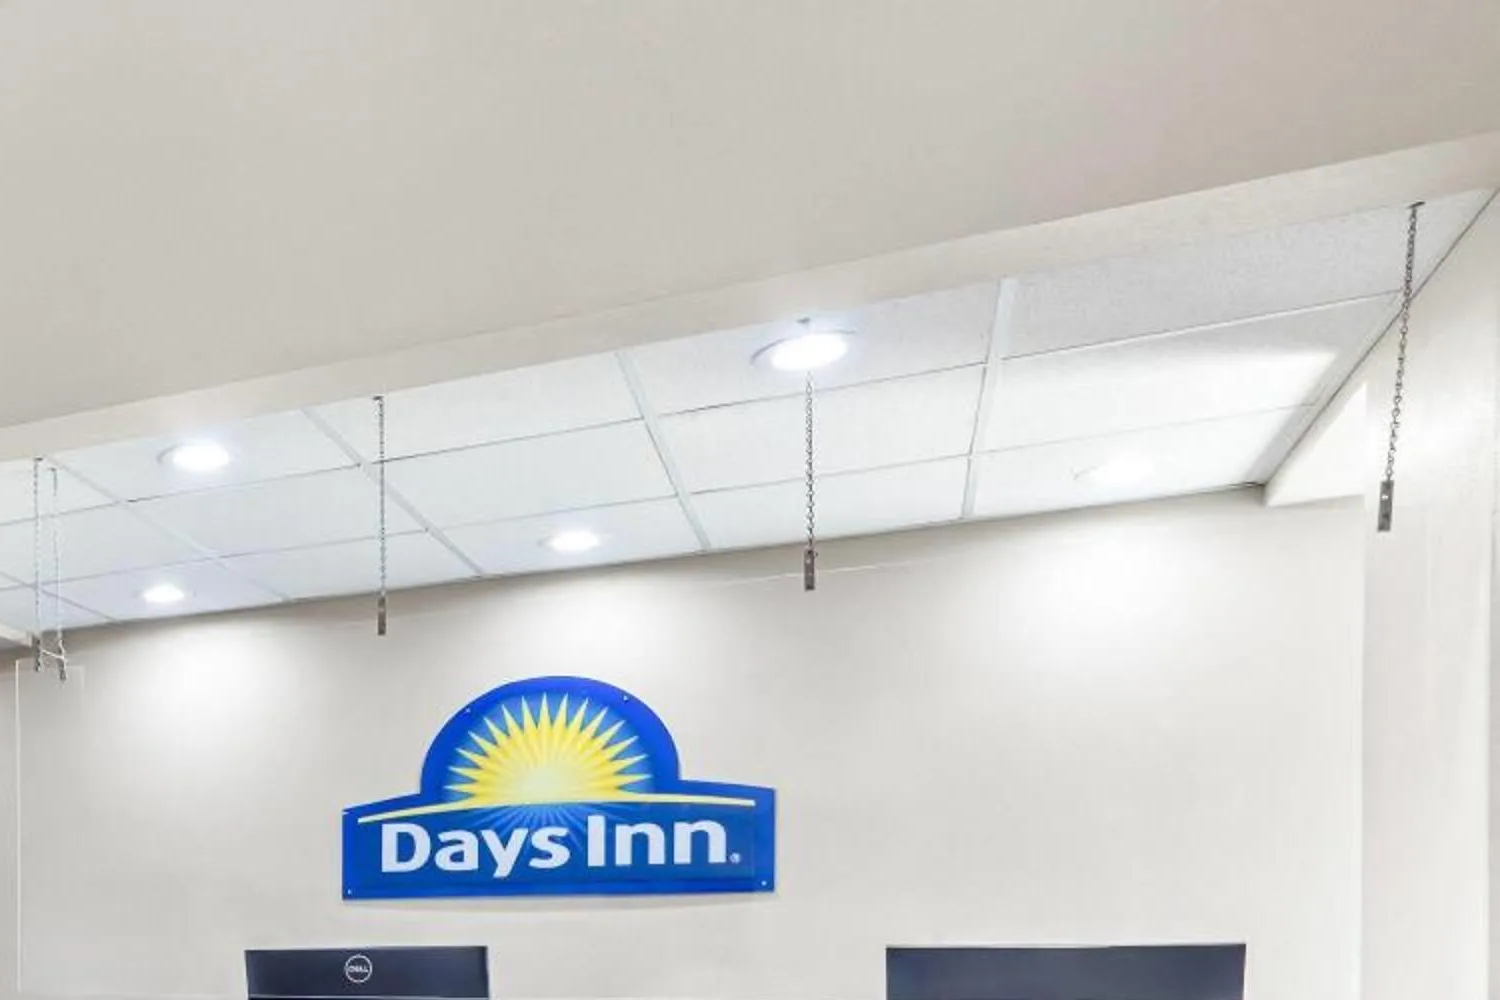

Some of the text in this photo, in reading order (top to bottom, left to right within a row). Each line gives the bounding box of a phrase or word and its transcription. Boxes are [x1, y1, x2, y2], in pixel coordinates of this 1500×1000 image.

[381, 815, 727, 878] Days Inn
[348, 965, 369, 973] DELL
